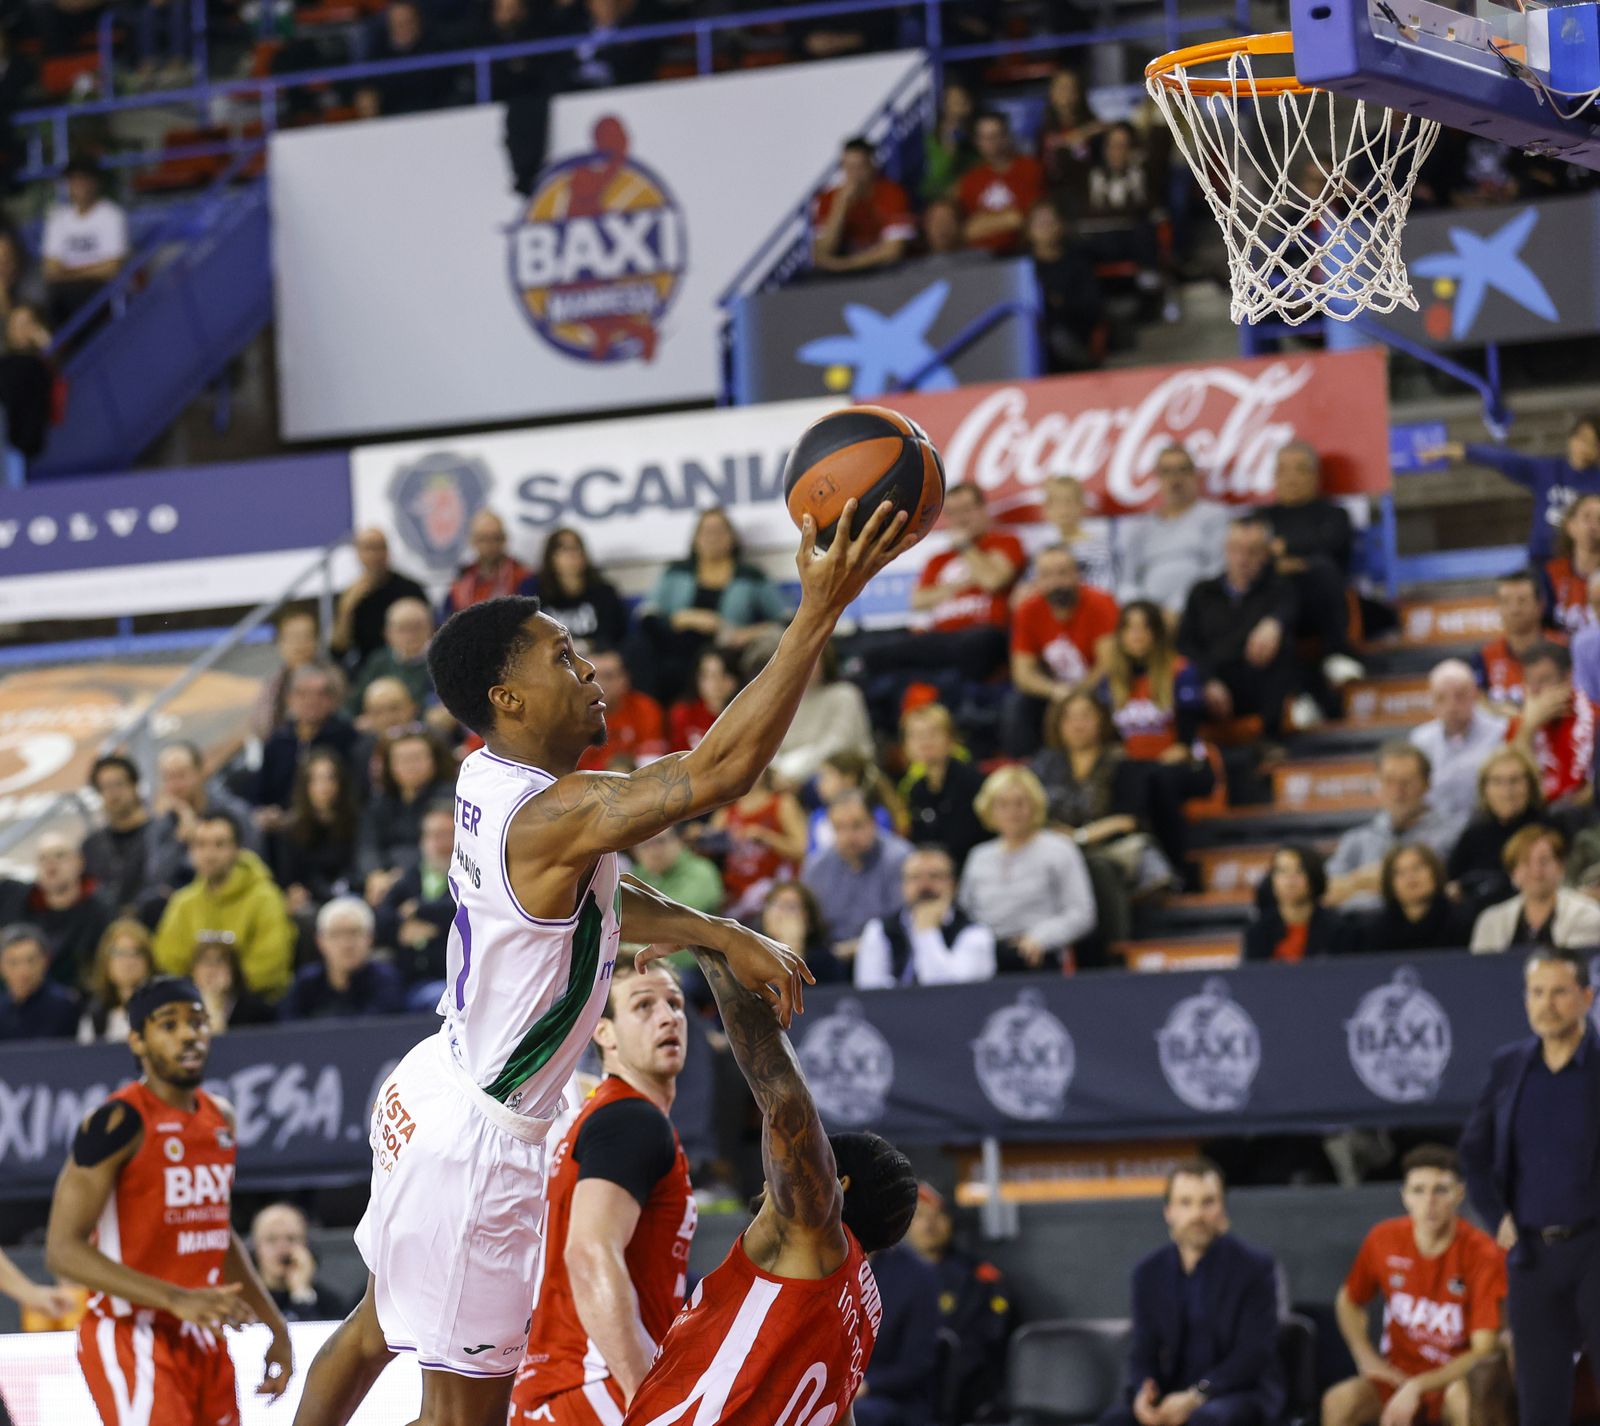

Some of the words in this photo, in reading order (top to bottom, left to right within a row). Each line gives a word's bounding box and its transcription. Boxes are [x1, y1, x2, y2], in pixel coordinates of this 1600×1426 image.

[516, 209, 678, 287] BAXI
[1356, 1023, 1444, 1056] BAXI
[164, 1163, 236, 1208] BAX
[1390, 1291, 1464, 1335] BAXI
